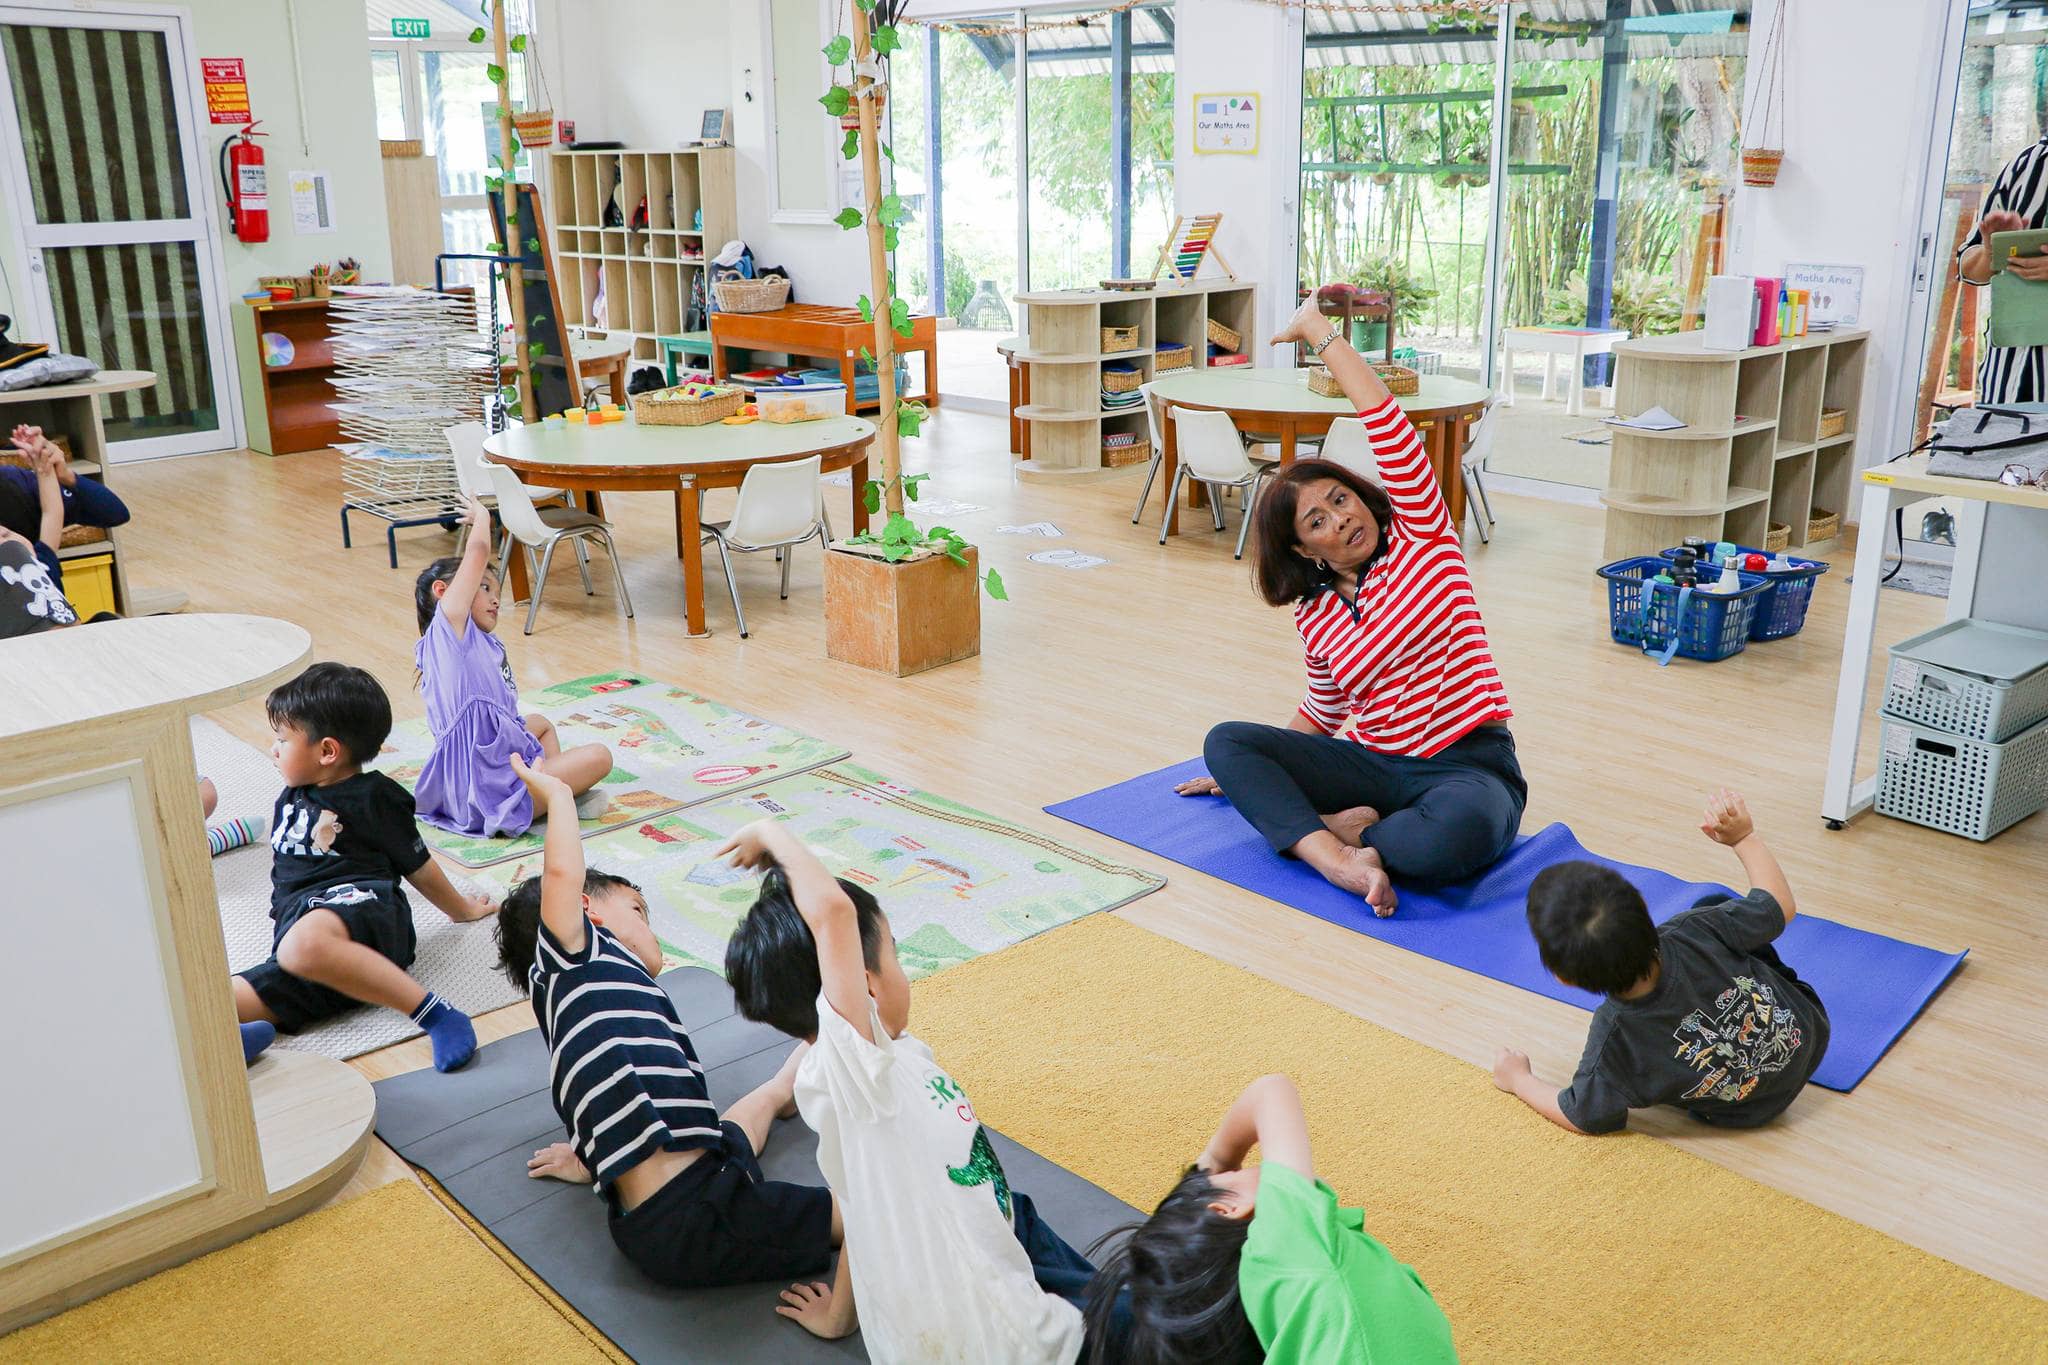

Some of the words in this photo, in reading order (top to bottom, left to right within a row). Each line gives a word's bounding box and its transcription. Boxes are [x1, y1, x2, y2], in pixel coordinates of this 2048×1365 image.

[396, 21, 426, 36] EXIT
[1198, 121, 1211, 129] Our
[1214, 121, 1234, 129] Maths
[1236, 121, 1250, 129] Area
[1795, 272, 1824, 283] Maths
[1828, 275, 1852, 285] Area
